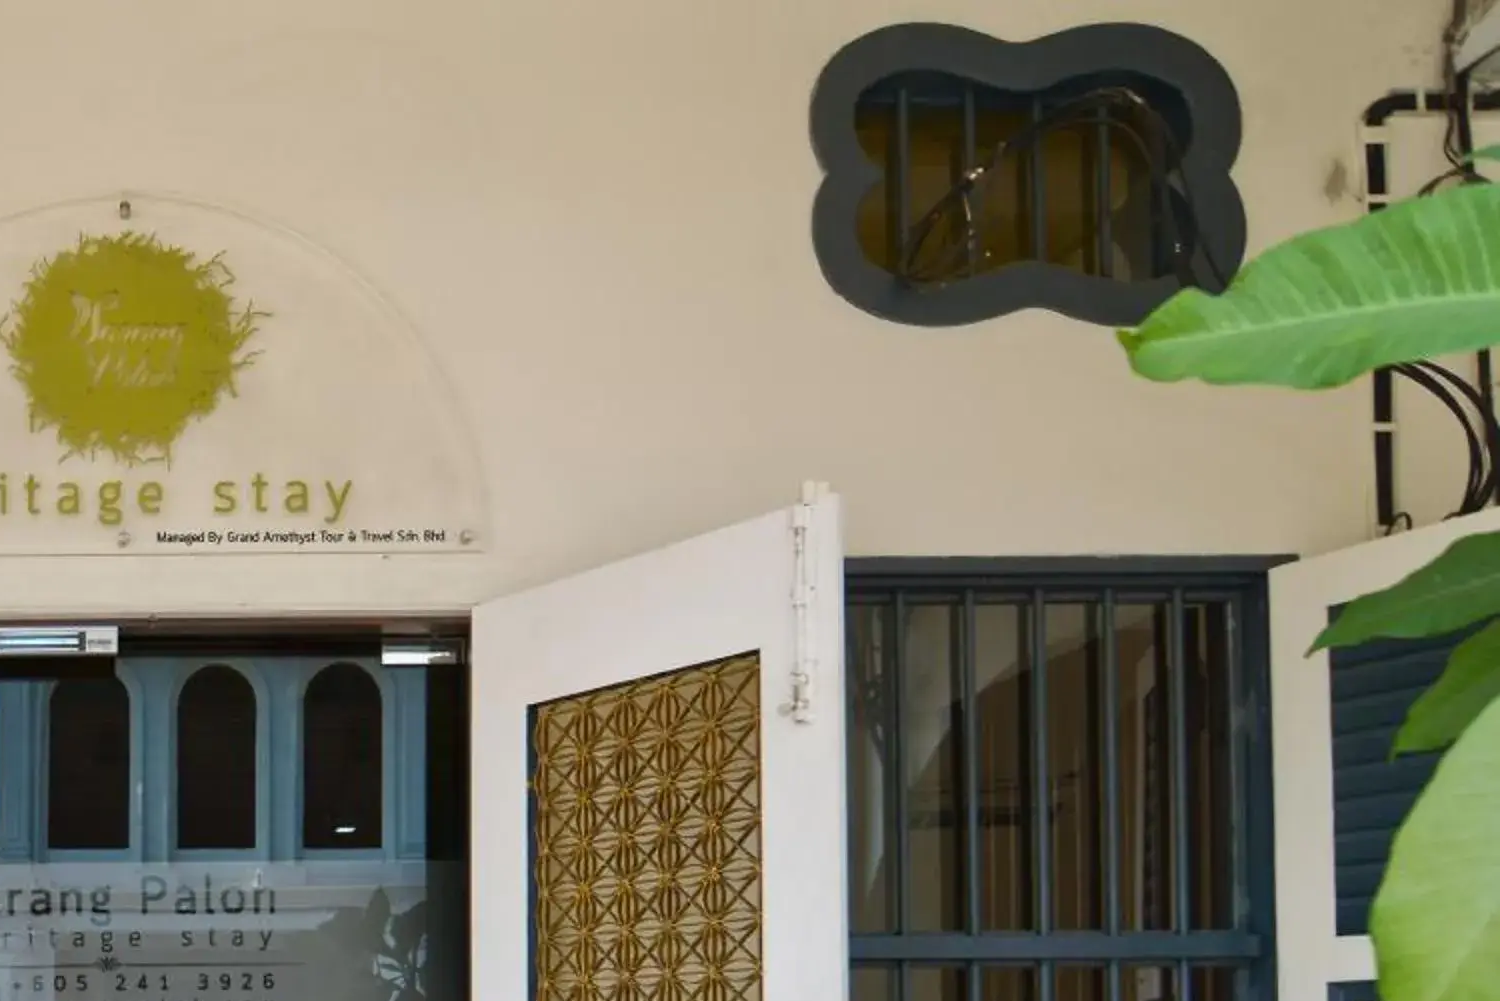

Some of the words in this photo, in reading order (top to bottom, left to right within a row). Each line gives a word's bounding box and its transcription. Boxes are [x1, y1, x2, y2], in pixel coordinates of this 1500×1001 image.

[213, 473, 355, 523] stay
[156, 530, 205, 546] Managed
[207, 530, 223, 545] By
[227, 530, 260, 543] Grand
[263, 529, 315, 545] Amethyst
[320, 529, 344, 543] Tour
[360, 529, 393, 542] Travel
[181, 927, 273, 951] stay
[13, 974, 89, 992] +605
[115, 973, 170, 992] 241
[196, 972, 276, 991] 3926
